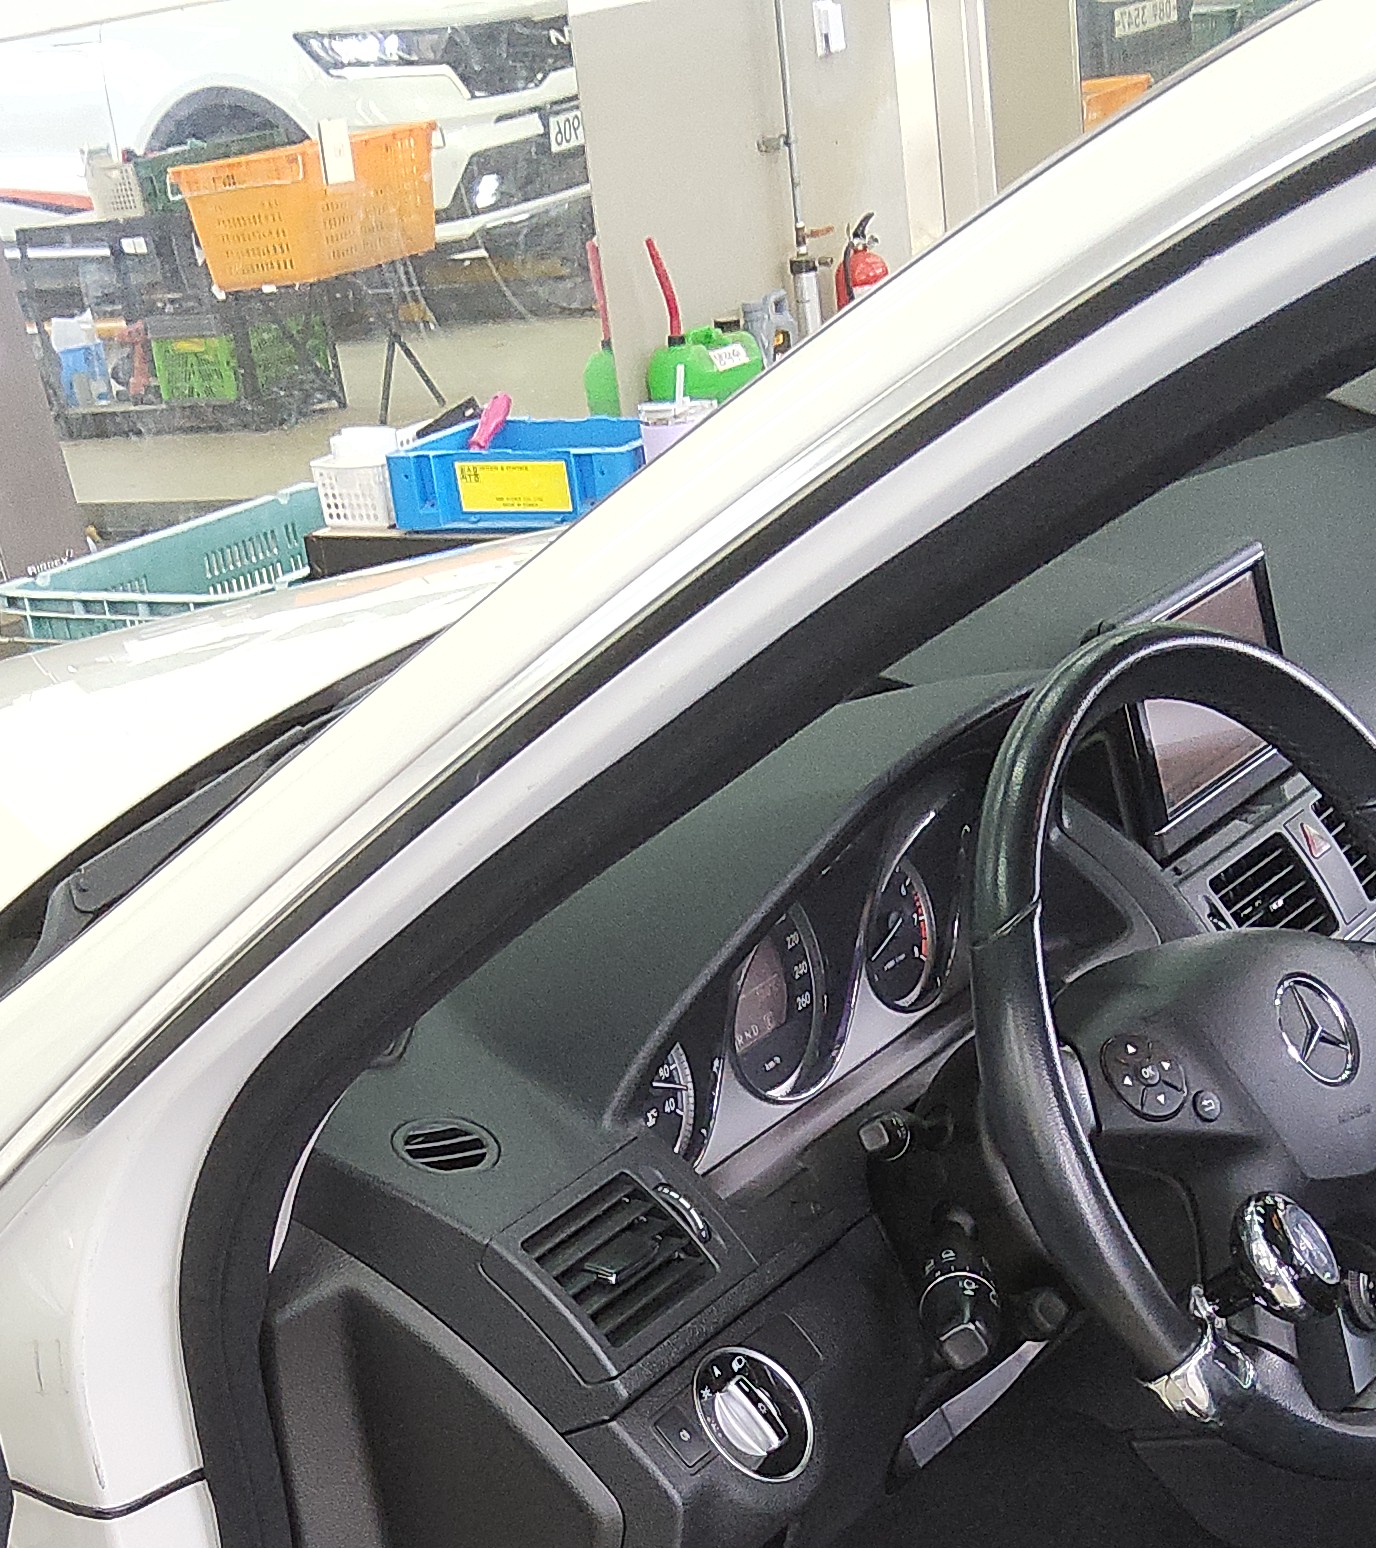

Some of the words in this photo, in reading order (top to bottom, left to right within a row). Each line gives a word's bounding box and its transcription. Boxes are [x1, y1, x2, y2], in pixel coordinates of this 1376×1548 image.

[793, 960, 808, 980] 240
[796, 991, 811, 1011] 260
[1141, 1065, 1156, 1079] OK
[664, 1097, 676, 1114] 40
